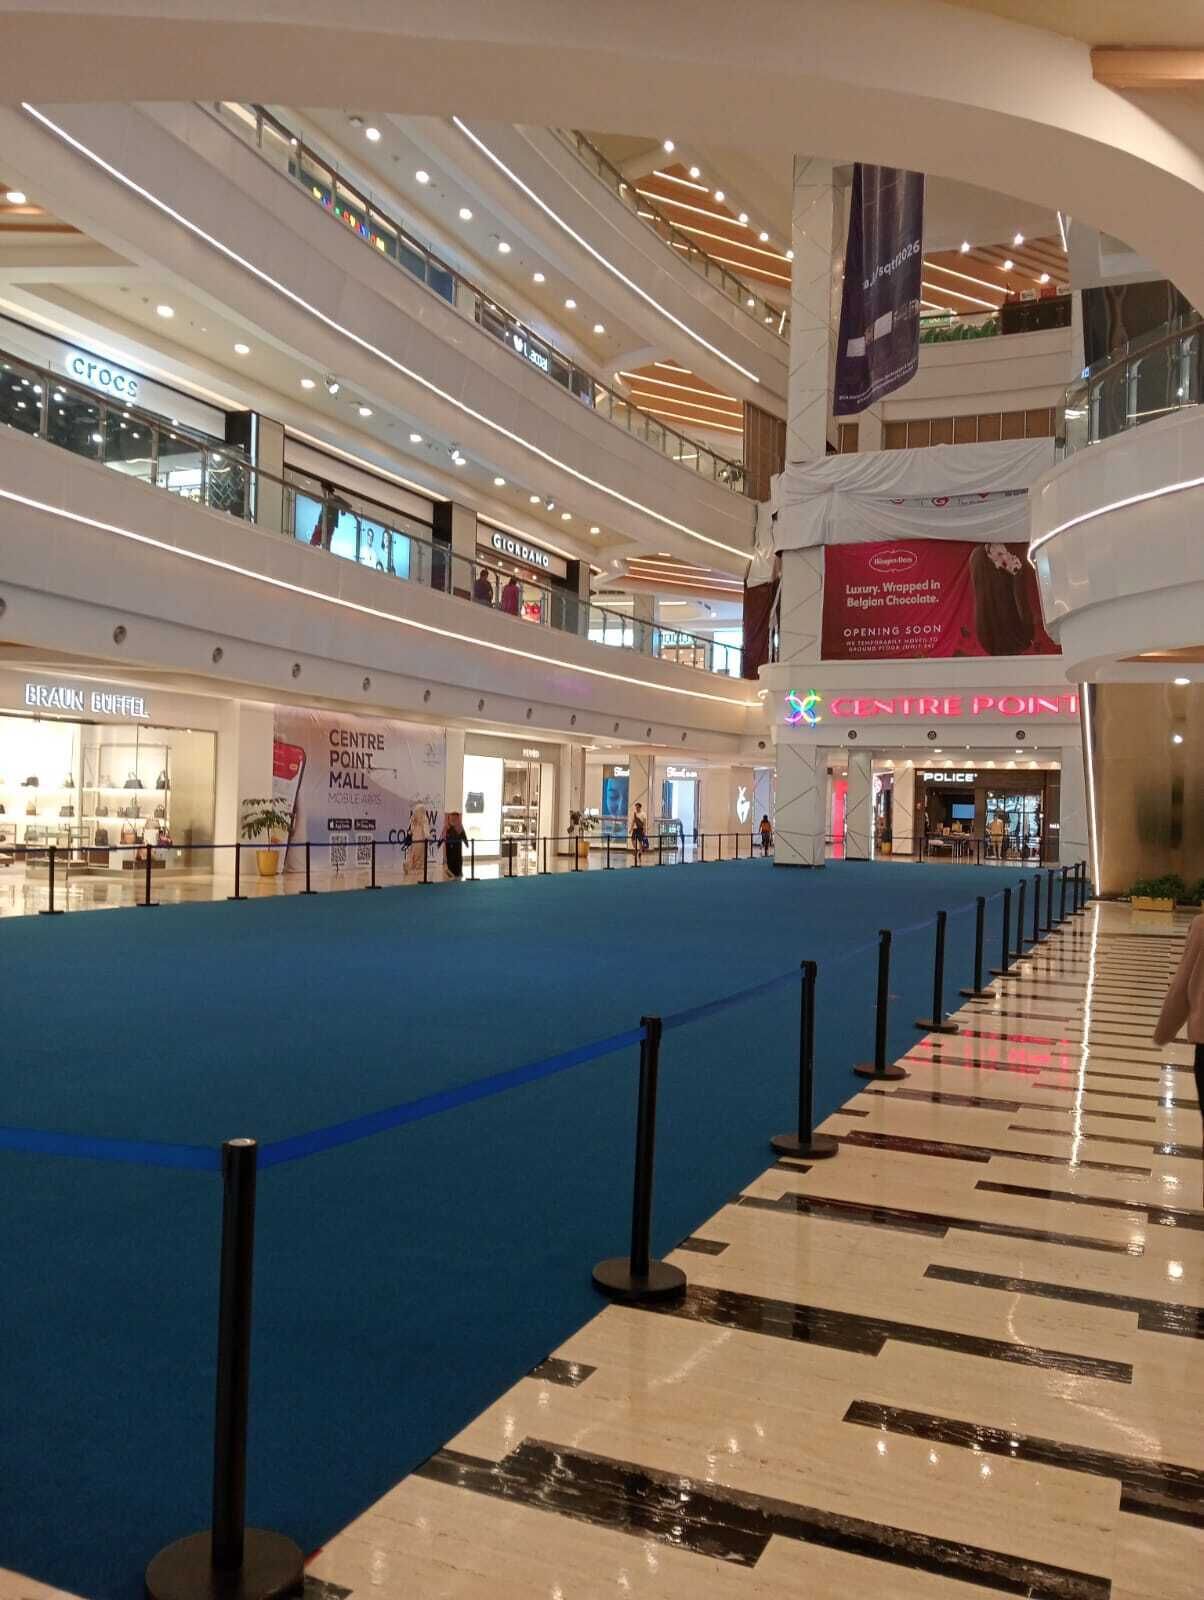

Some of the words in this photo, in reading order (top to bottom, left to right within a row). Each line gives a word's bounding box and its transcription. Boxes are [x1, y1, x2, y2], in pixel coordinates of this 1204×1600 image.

[72, 357, 138, 397] crocs
[491, 533, 549, 568] GIORDANO
[845, 584, 881, 596] Luxury.
[882, 580, 929, 594] Wrapped
[930, 579, 940, 589] in
[847, 597, 884, 609] Belgian
[885, 594, 940, 606] Chocolate.
[843, 626, 900, 638] OPENING
[905, 624, 942, 635] SOON
[25, 683, 84, 711] BRAUN
[830, 695, 963, 718] CENTRE
[972, 694, 1080, 717] POINT
[329, 729, 385, 750] CENTRE
[330, 750, 374, 769] POINT
[329, 771, 369, 790] MALL
[923, 772, 975, 782] POLICE
